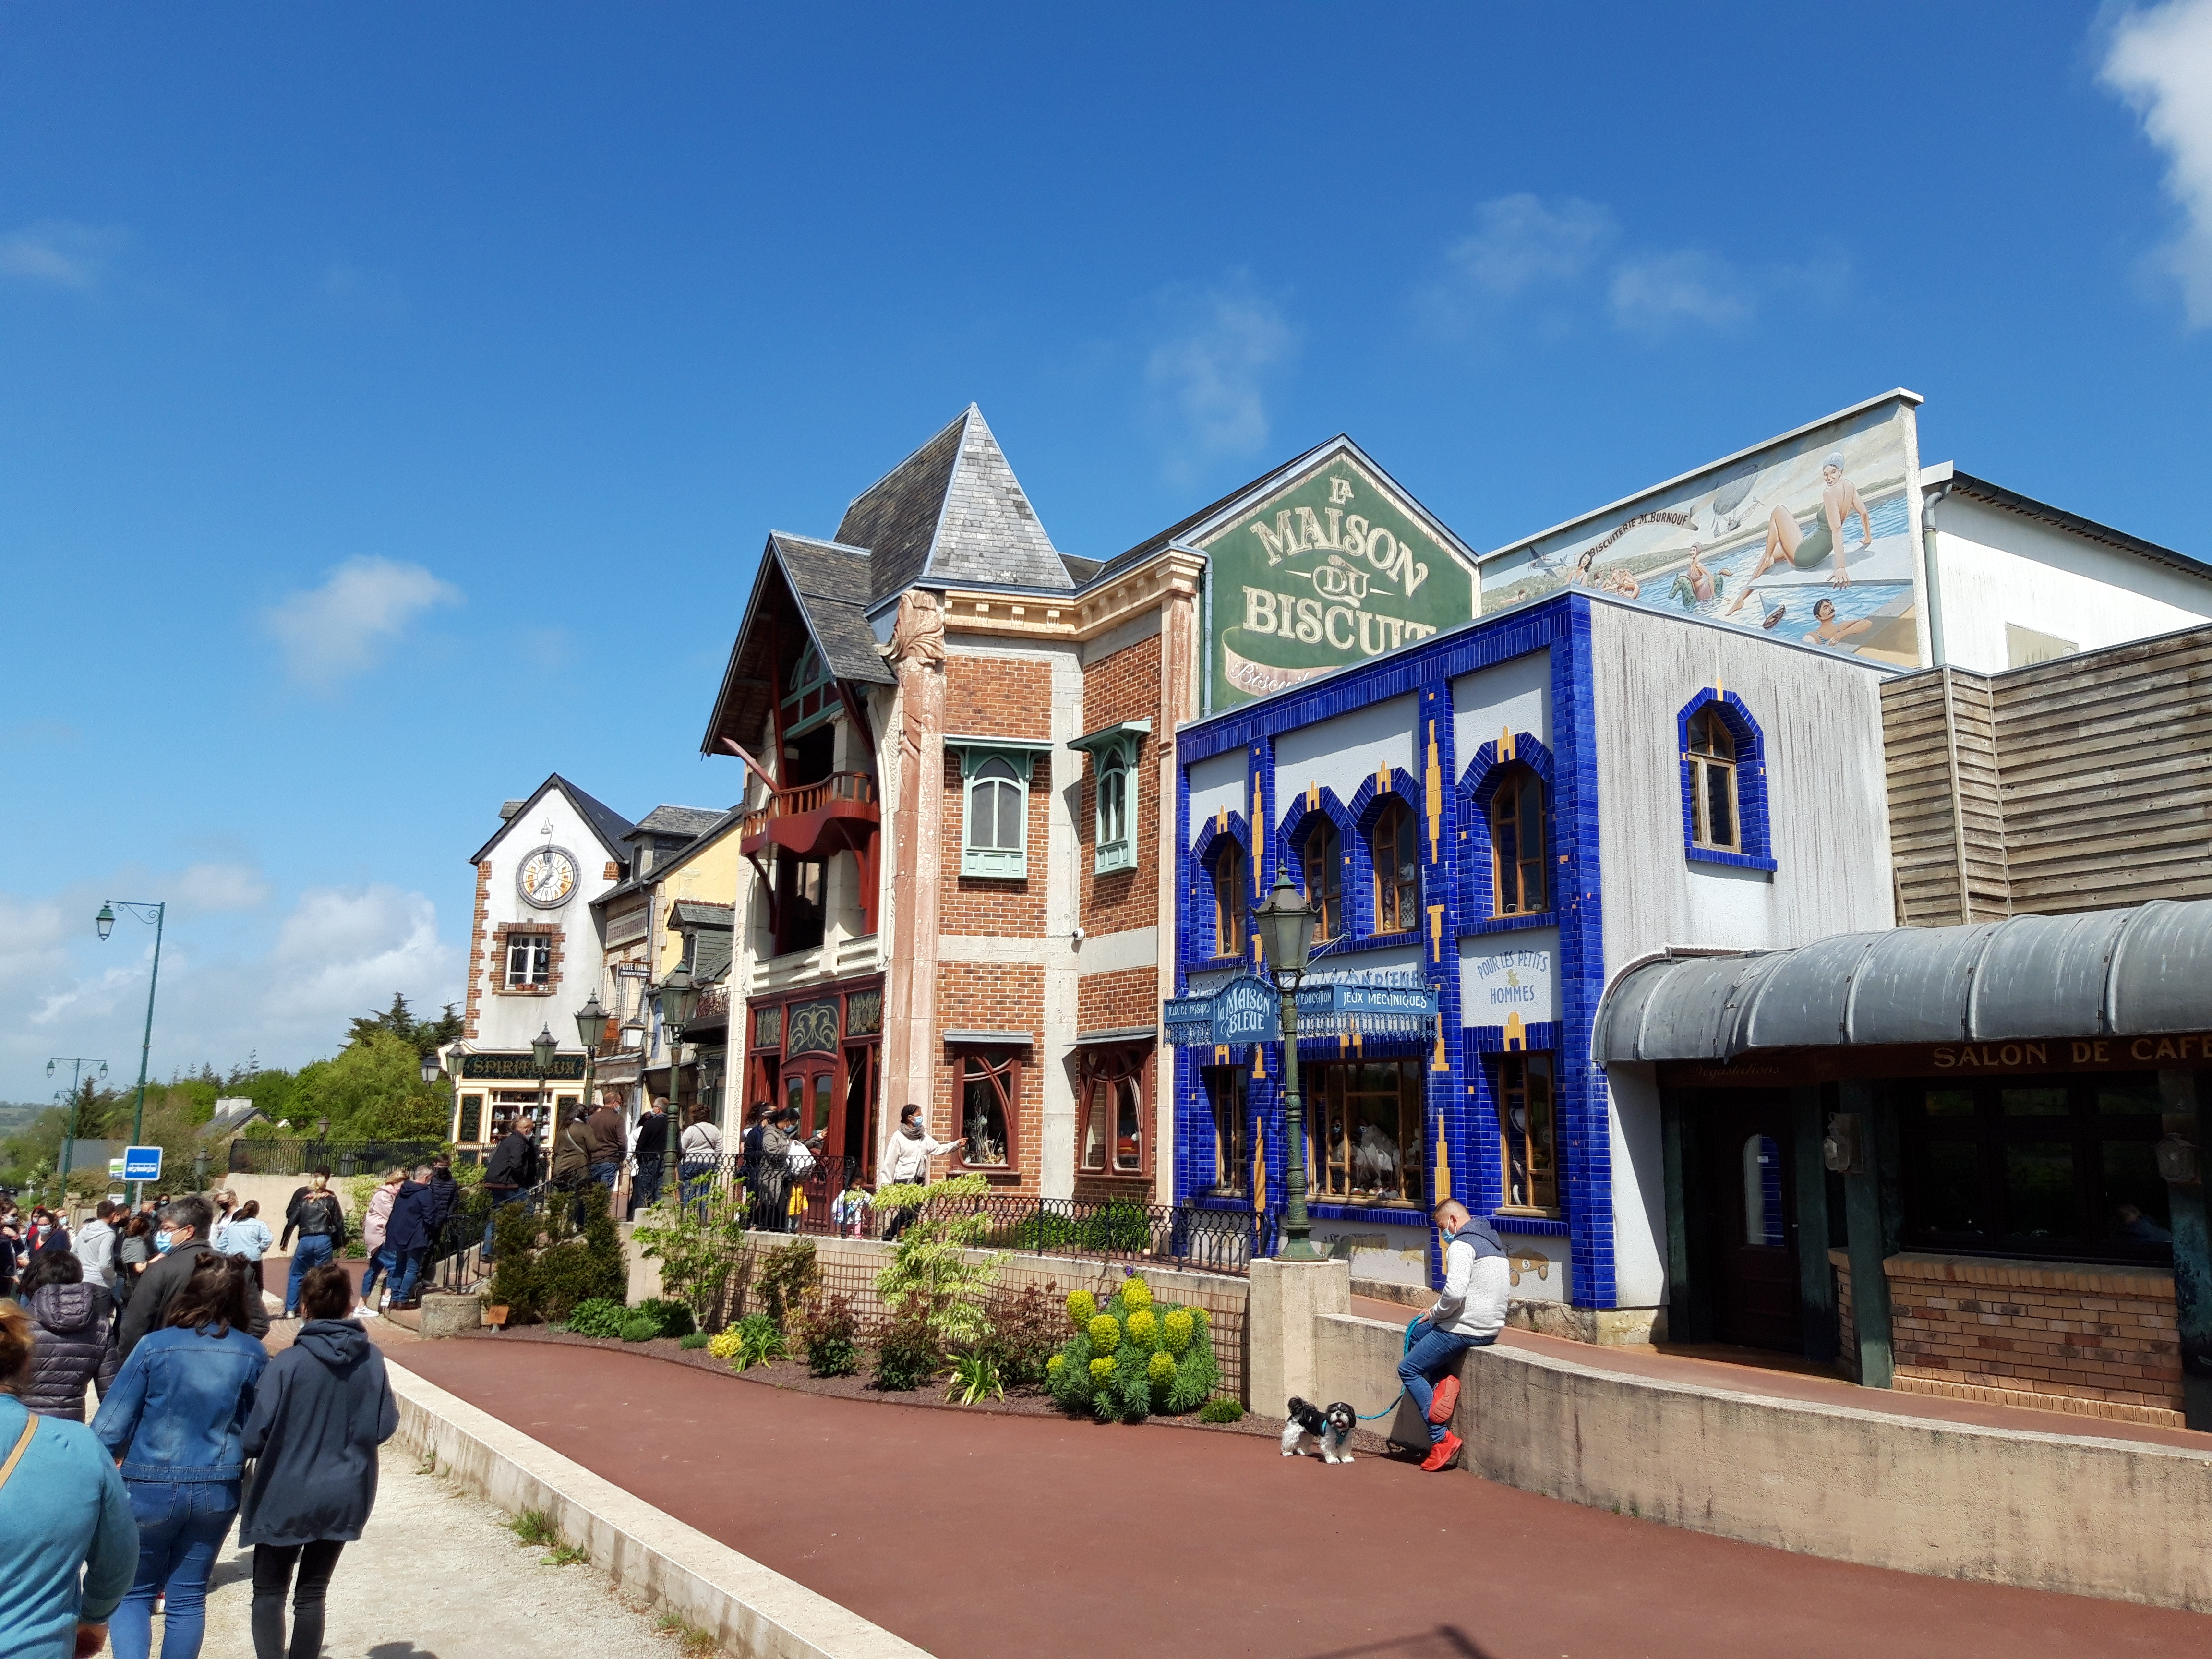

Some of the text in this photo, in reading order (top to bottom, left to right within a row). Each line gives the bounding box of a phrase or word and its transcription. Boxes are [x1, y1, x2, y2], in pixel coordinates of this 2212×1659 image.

[1329, 476, 1355, 505] LA
[1590, 519, 1636, 556] BISCUITERIE
[1250, 506, 1429, 598] MAISON
[1312, 554, 1370, 608] DU
[1477, 950, 1549, 980] POUR LES PETITS
[1344, 991, 1364, 1006] JEUX
[1491, 984, 1535, 1004] HOMMES
[1168, 1006, 1179, 1018] JEUX
[1181, 1006, 1188, 1014] DE
[1220, 987, 1270, 1035] MAISON
[1226, 1011, 1264, 1038] BLEUE
[1934, 1043, 2047, 1068] SALON
[2072, 1041, 2109, 1063] DE
[1524, 1260, 1528, 1269] 3
